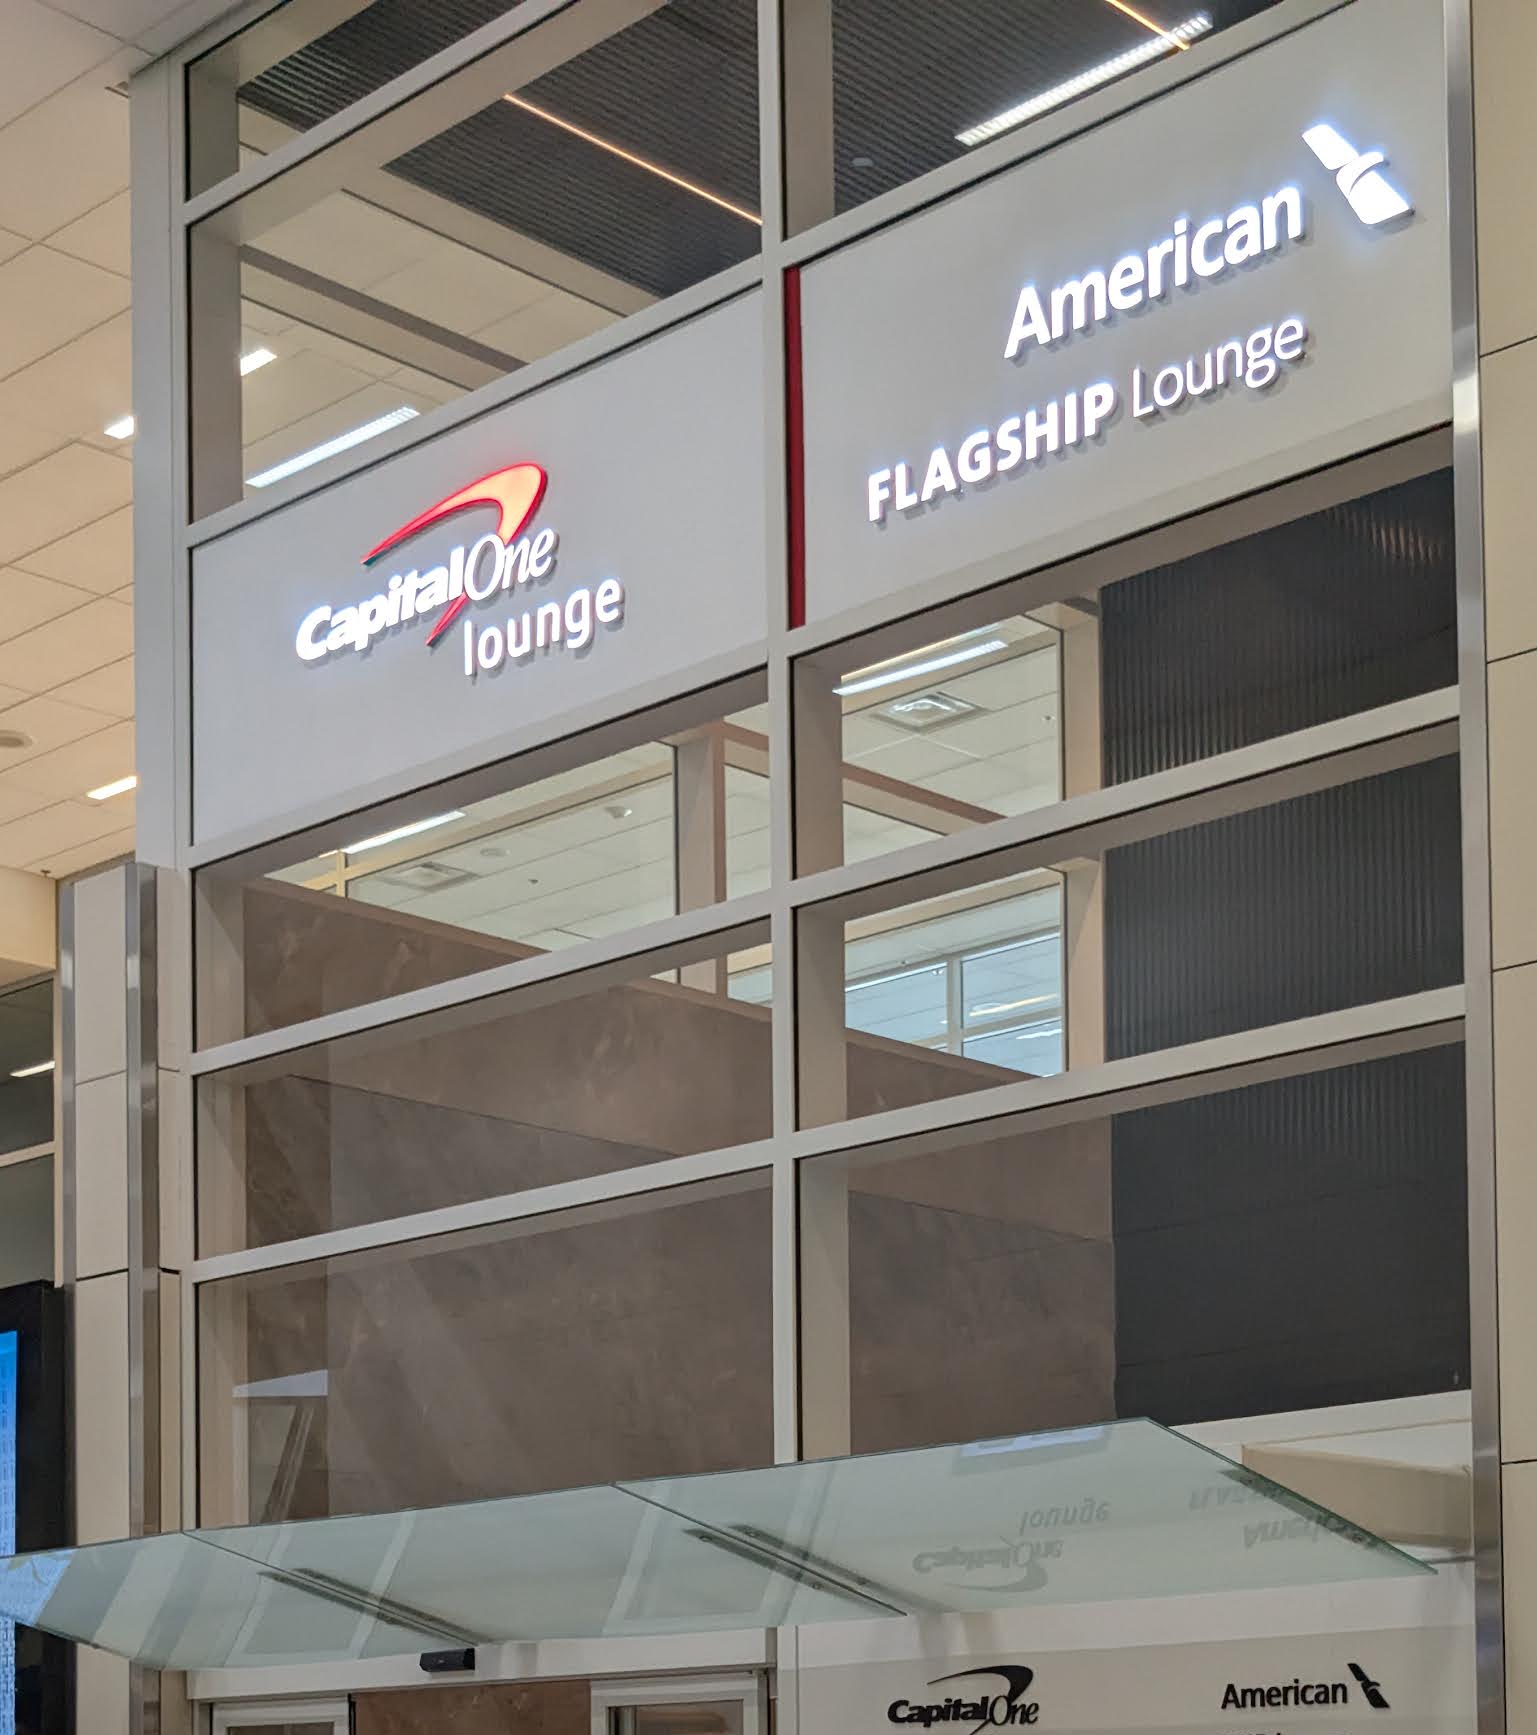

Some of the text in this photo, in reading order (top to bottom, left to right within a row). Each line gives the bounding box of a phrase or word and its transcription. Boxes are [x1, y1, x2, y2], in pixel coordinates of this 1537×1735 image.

[1002, 183, 1304, 361] American
[866, 314, 1306, 523] FLAGSHIP Lounge
[463, 576, 623, 677] lounge
[1220, 1678, 1349, 1711] American
